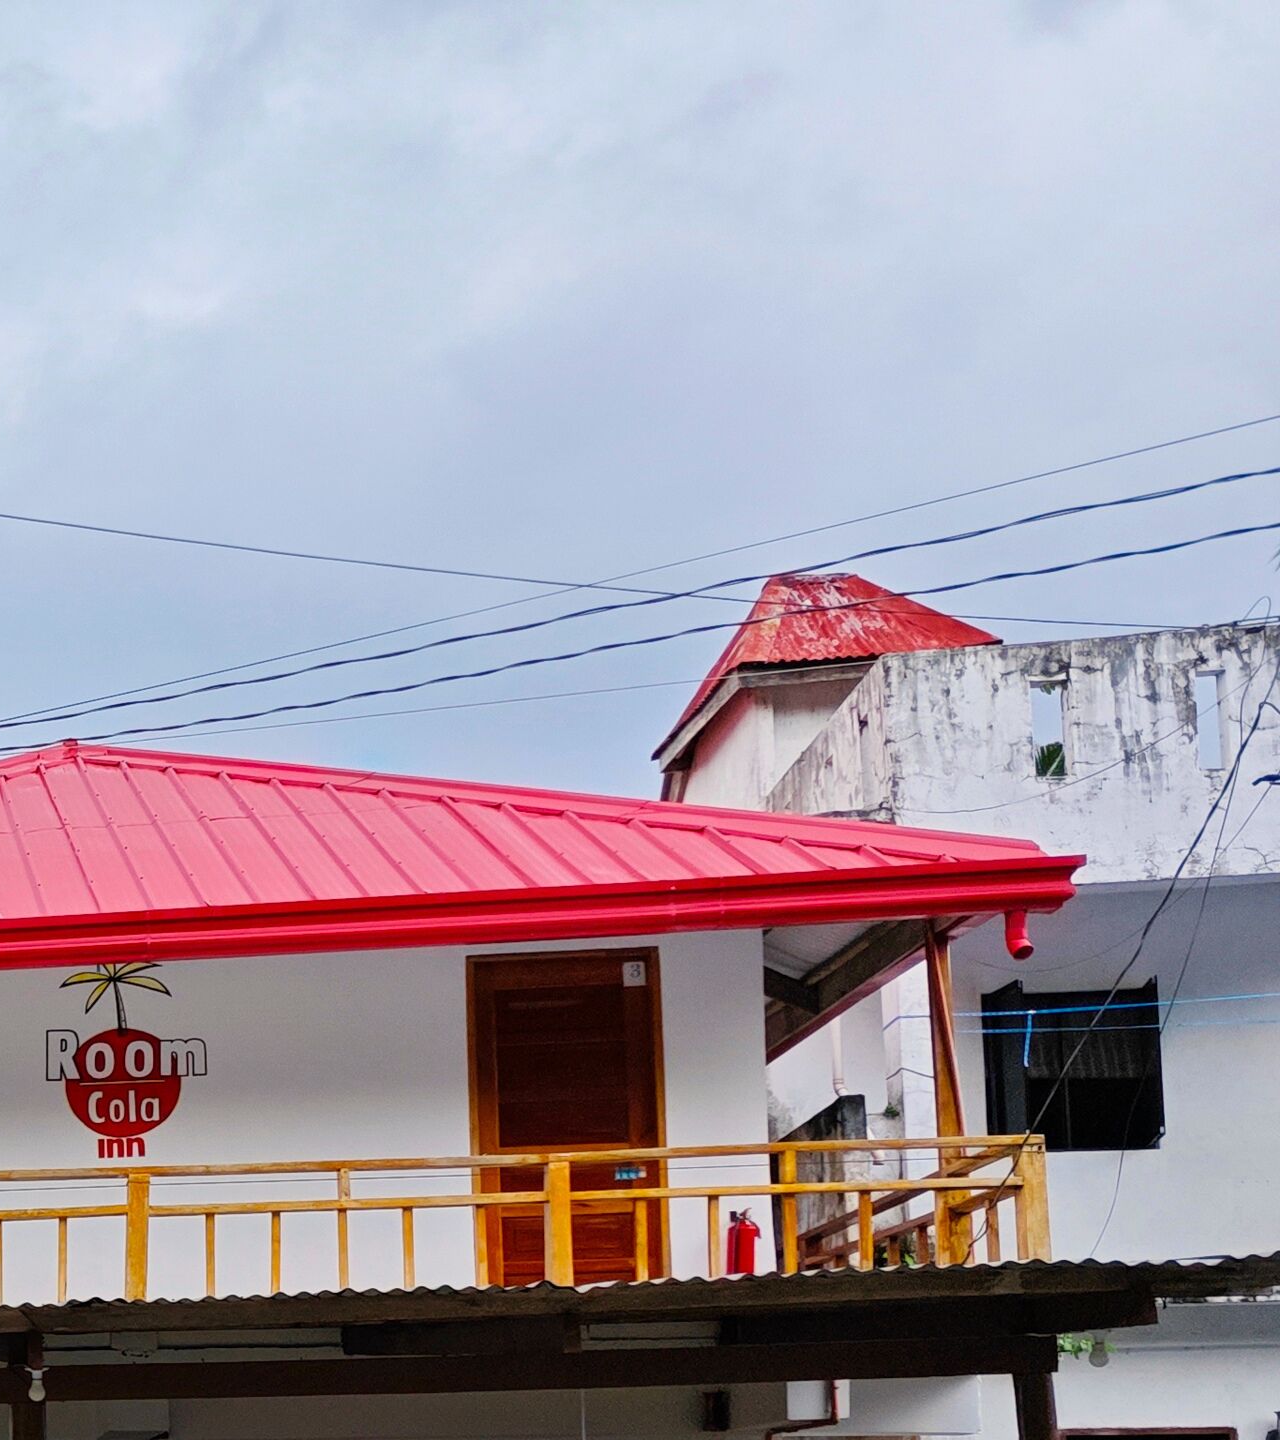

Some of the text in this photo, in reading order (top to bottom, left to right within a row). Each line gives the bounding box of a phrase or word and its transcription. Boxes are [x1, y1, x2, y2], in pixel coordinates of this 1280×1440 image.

[630, 963, 641, 978] 3
[46, 1029, 208, 1081] Room
[88, 1090, 160, 1123] Cola
